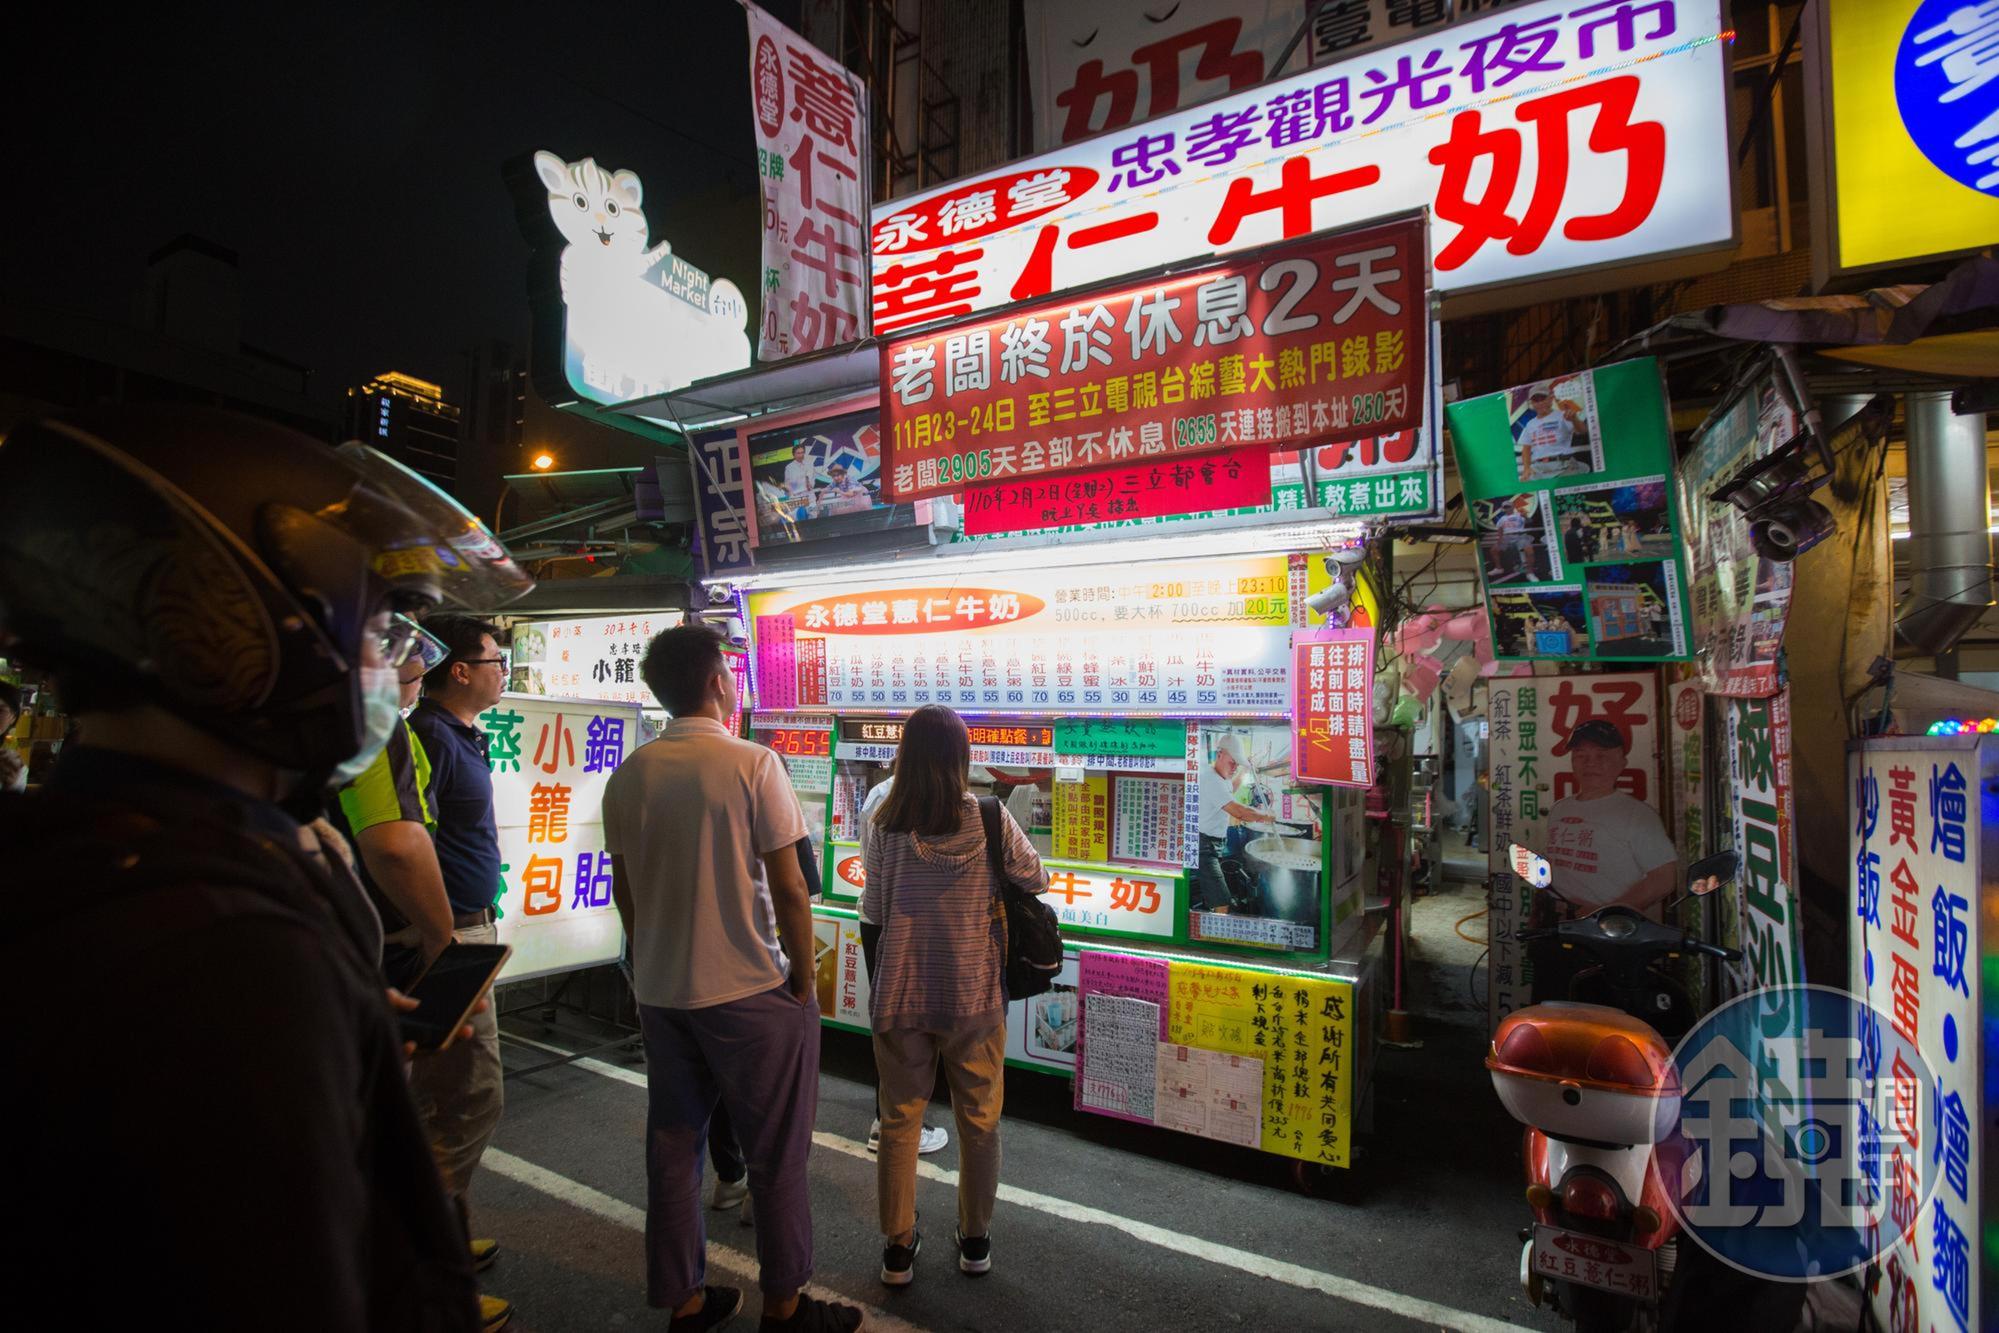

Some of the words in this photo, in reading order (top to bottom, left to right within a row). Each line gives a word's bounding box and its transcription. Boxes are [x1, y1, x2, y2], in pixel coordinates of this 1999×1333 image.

[758, 42, 780, 128] 永德堂
[1107, 0, 1677, 193] 忠孝觀光夜市
[786, 44, 862, 355] 薏仁牛奶
[873, 168, 1072, 254] 永德堂
[672, 258, 709, 291] Night
[661, 270, 707, 310] Market
[891, 245, 1403, 407] 老闆終於休息2天
[893, 397, 1016, 452] 11月23-24日
[1028, 329, 1405, 428] 至三立電視台綜藝大熱門錄影
[804, 593, 1022, 629] 永德堂薏仁牛奶
[1171, 601, 1220, 618] 700cc
[1309, 646, 1326, 713] 最好成
[830, 690, 843, 701] 70
[851, 690, 865, 702] 55
[872, 690, 885, 702] 50
[893, 690, 907, 702] 55
[915, 690, 930, 702] 55
[937, 690, 952, 702] 55
[961, 690, 975, 702] 55
[984, 690, 999, 702] 55
[1007, 690, 1023, 702] 60
[1033, 690, 1048, 702] 70
[1058, 690, 1075, 702] 65
[1084, 691, 1100, 702] 55
[1112, 691, 1129, 703] 30
[1139, 691, 1157, 703] 45
[1168, 691, 1186, 703] 45
[1198, 691, 1216, 703] 55
[1328, 645, 1345, 737] 往前面排
[1347, 645, 1369, 783] 排隊時請盡量
[522, 713, 575, 916] 小籠包
[572, 714, 624, 911] 鍋貼
[1049, 872, 1161, 915] 牛奶
[843, 943, 858, 1009] 紅豆薏仁粥
